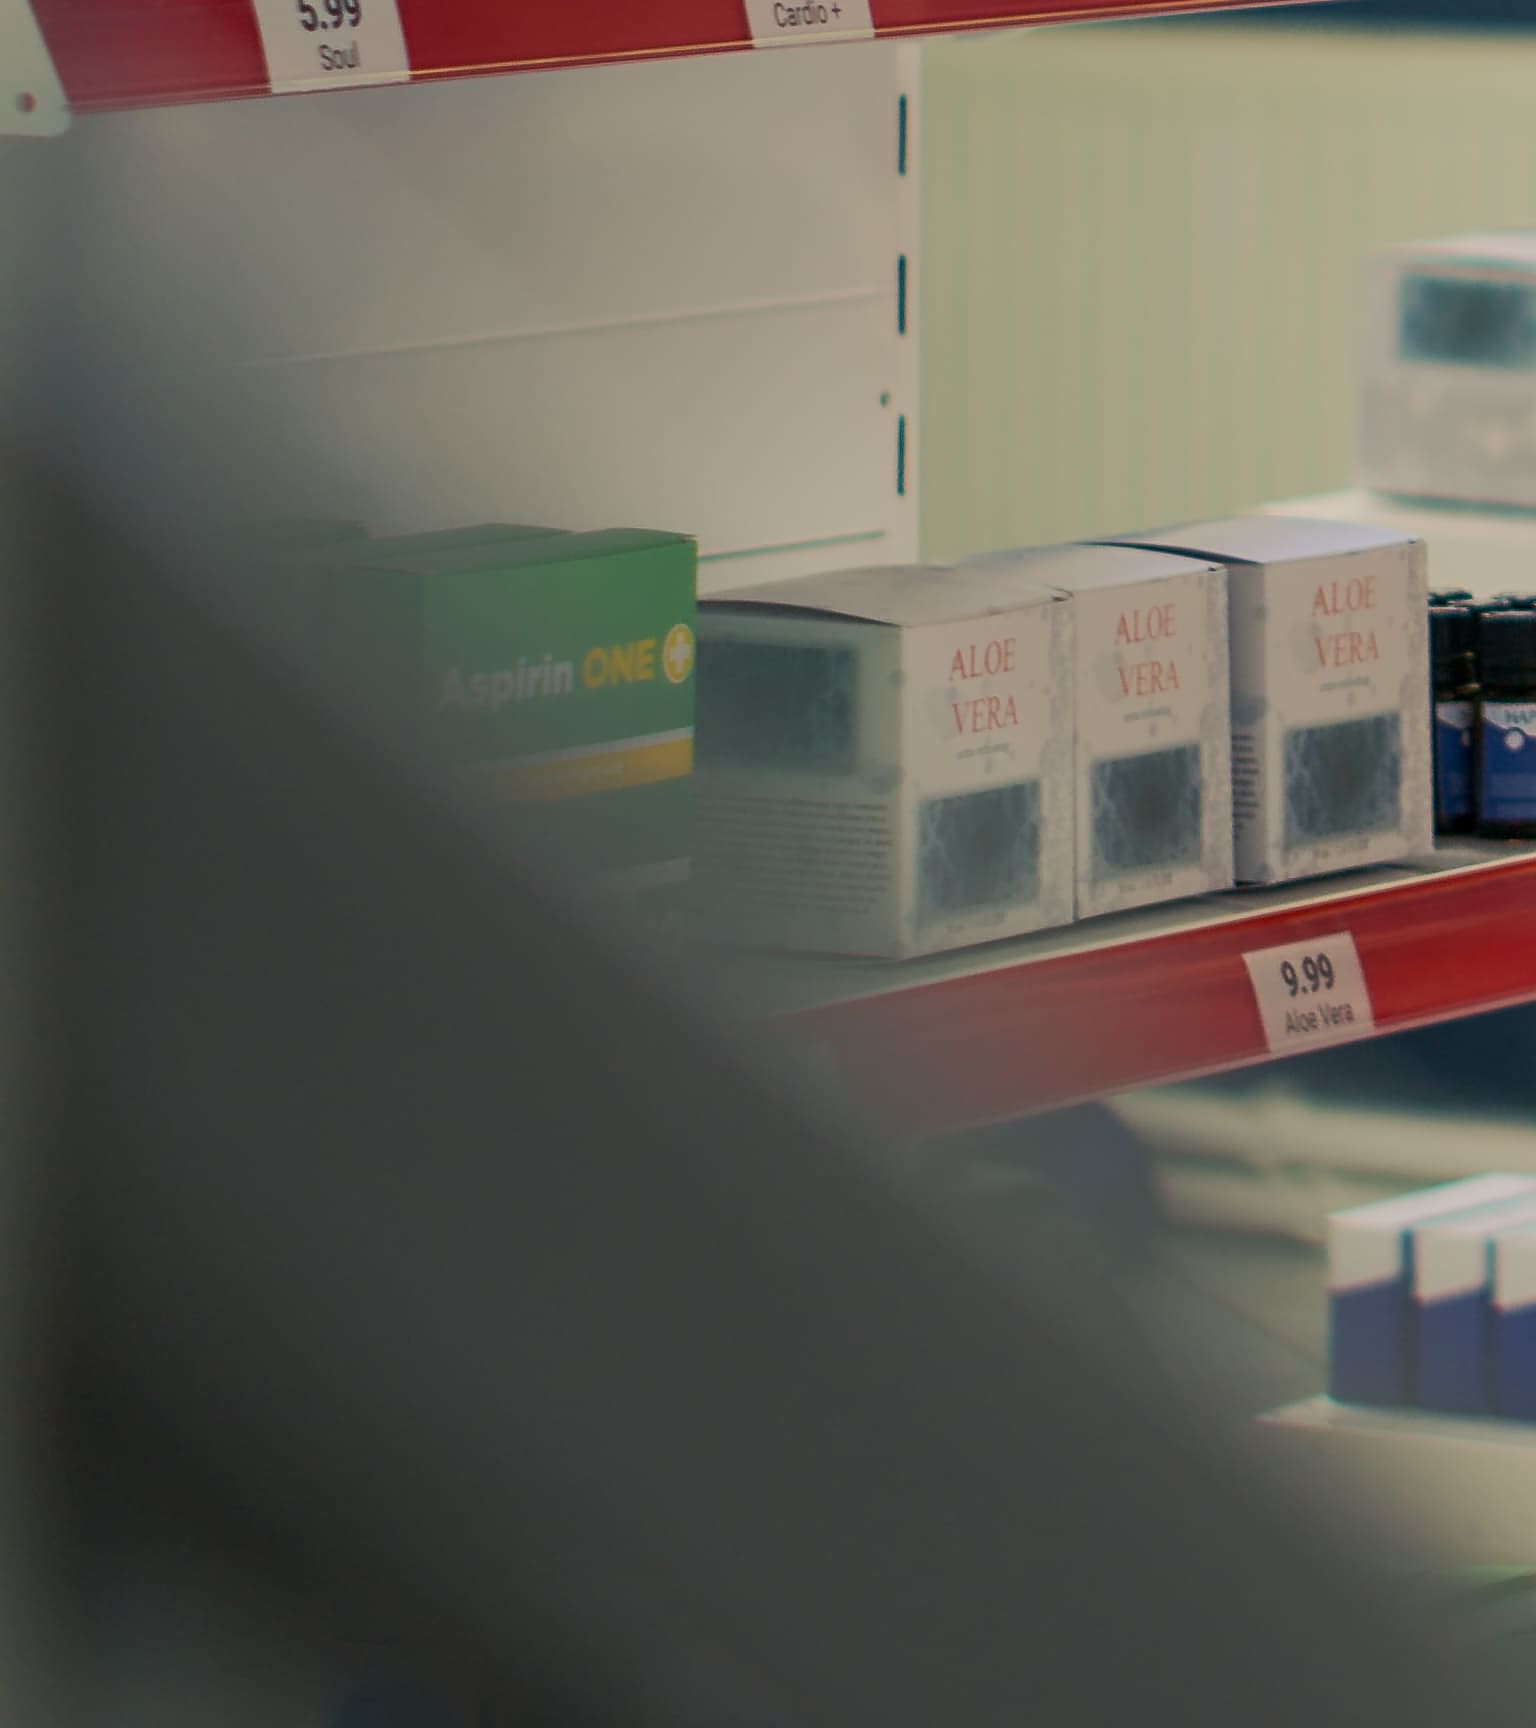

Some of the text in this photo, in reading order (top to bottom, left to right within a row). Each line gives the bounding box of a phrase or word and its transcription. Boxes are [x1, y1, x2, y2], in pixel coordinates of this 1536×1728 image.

[774, 0, 828, 28] Cardio
[319, 40, 360, 70] Soul
[1311, 575, 1377, 618] ALOE
[1113, 603, 1177, 646] ALOE
[948, 637, 1017, 682] ALOE
[1313, 630, 1381, 670] VERA
[440, 638, 656, 712] Aspirin ONE
[1117, 659, 1181, 698] VERA
[951, 694, 1020, 736] VERA
[1281, 953, 1334, 997] 9.99
